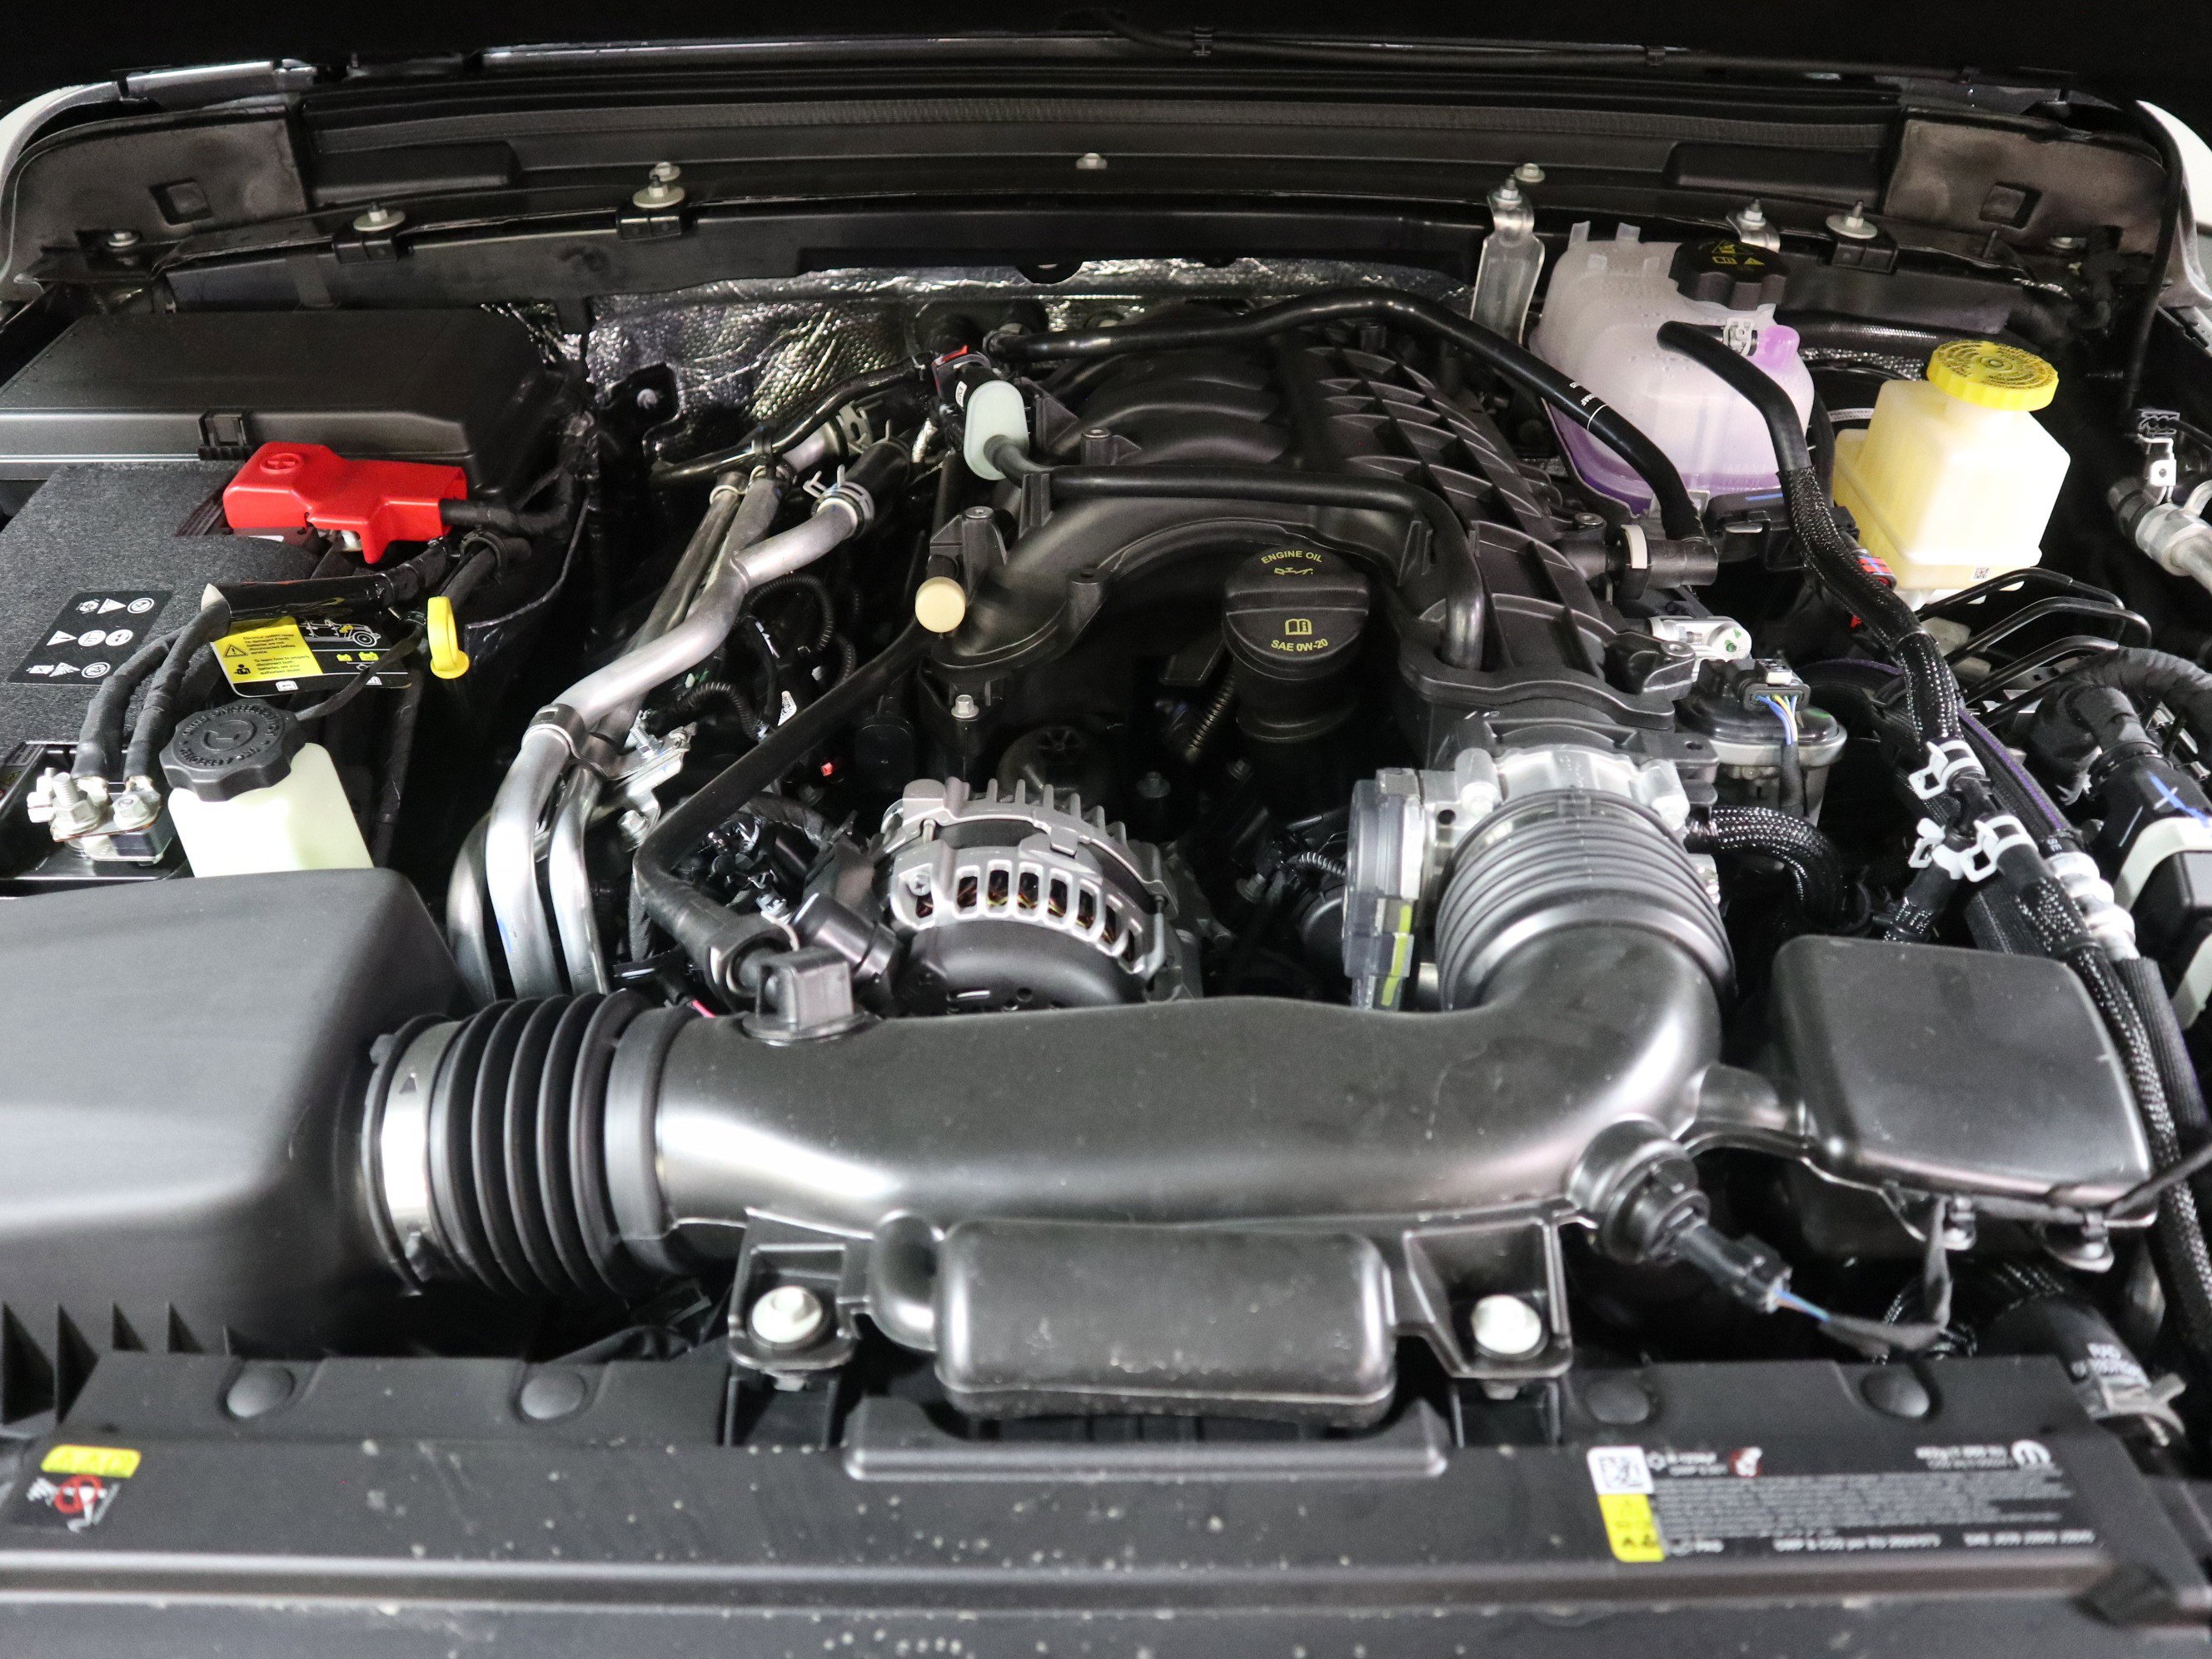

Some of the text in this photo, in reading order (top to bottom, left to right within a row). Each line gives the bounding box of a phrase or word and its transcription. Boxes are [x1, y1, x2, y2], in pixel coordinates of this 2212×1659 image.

[1260, 551, 1323, 565] ENGINE OIL
[1270, 638, 1328, 652] SAE 0W-20
